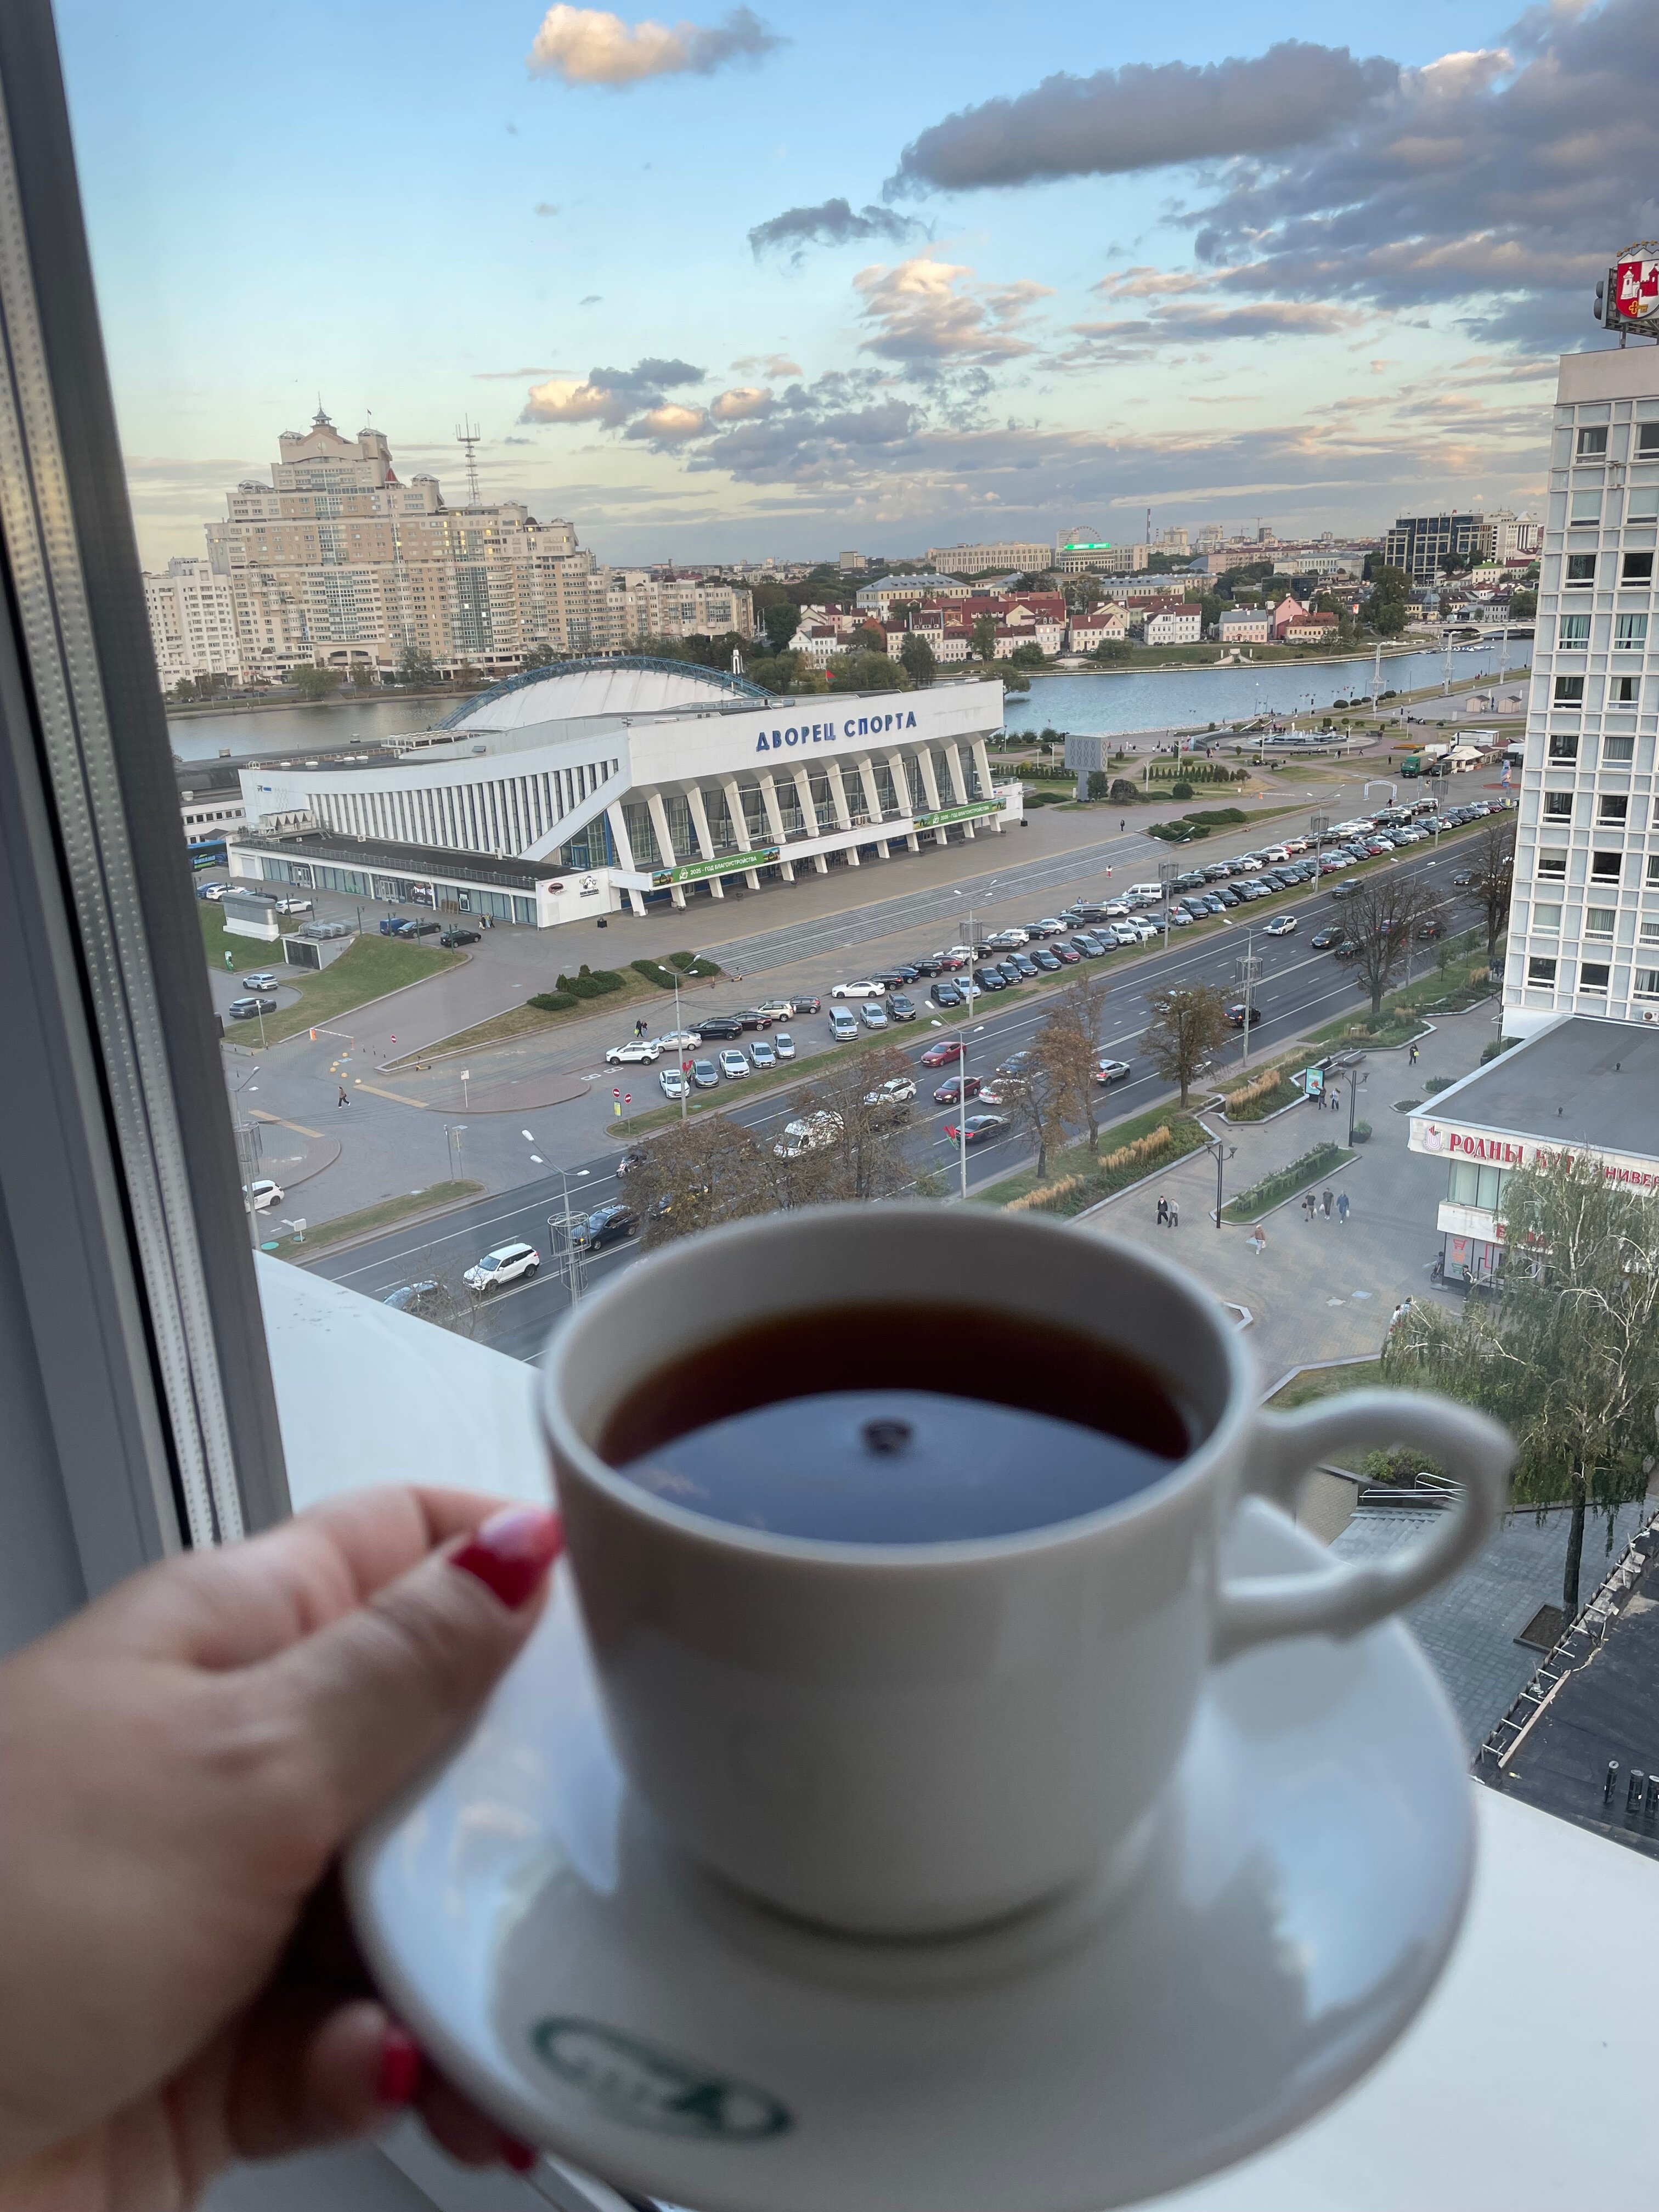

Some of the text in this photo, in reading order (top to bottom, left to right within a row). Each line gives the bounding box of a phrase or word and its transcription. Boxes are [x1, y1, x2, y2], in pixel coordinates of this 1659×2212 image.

[755, 711, 917, 752] ДВОРЕЦ СПОРТА
[715, 856, 757, 870] БЛАГОУСТРОЙСТВА
[1449, 1132, 1525, 1164] РОДНЫ
